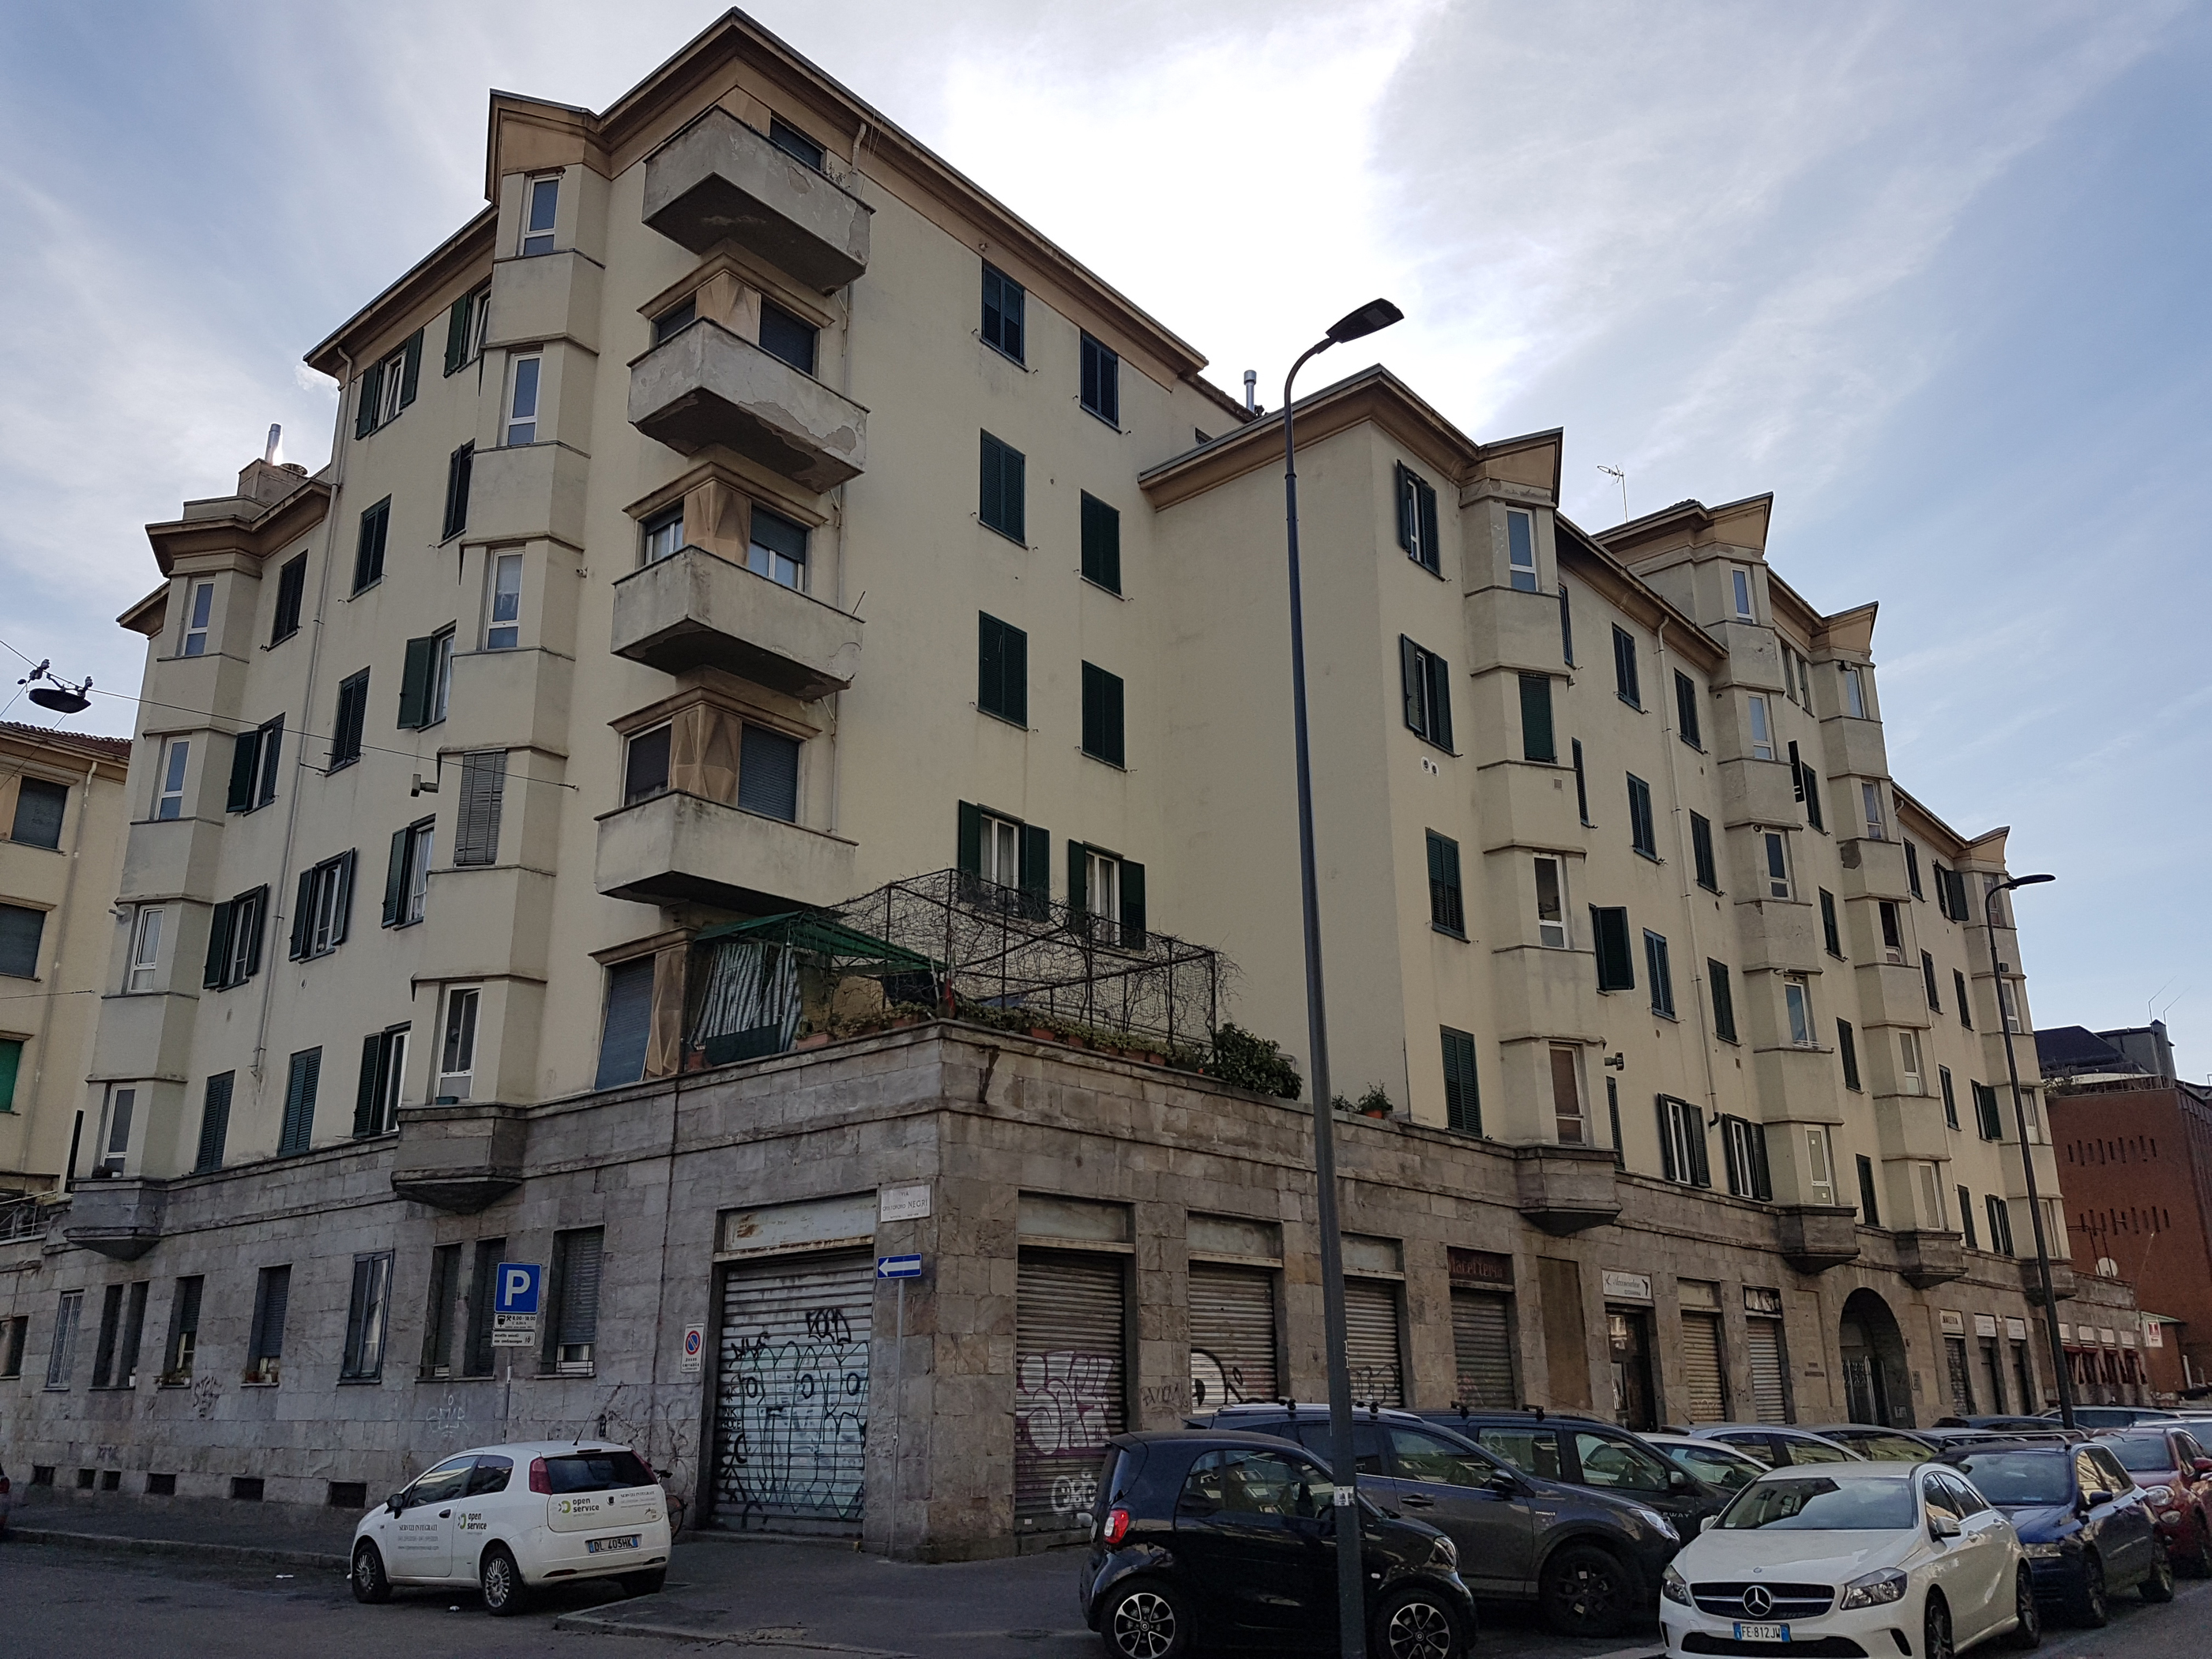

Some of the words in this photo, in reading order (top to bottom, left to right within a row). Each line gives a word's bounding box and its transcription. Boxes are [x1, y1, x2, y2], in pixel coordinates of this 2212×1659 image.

[908, 1198, 927, 1209] NEGRI
[504, 1269, 531, 1307] P
[467, 1522, 487, 1530] service
